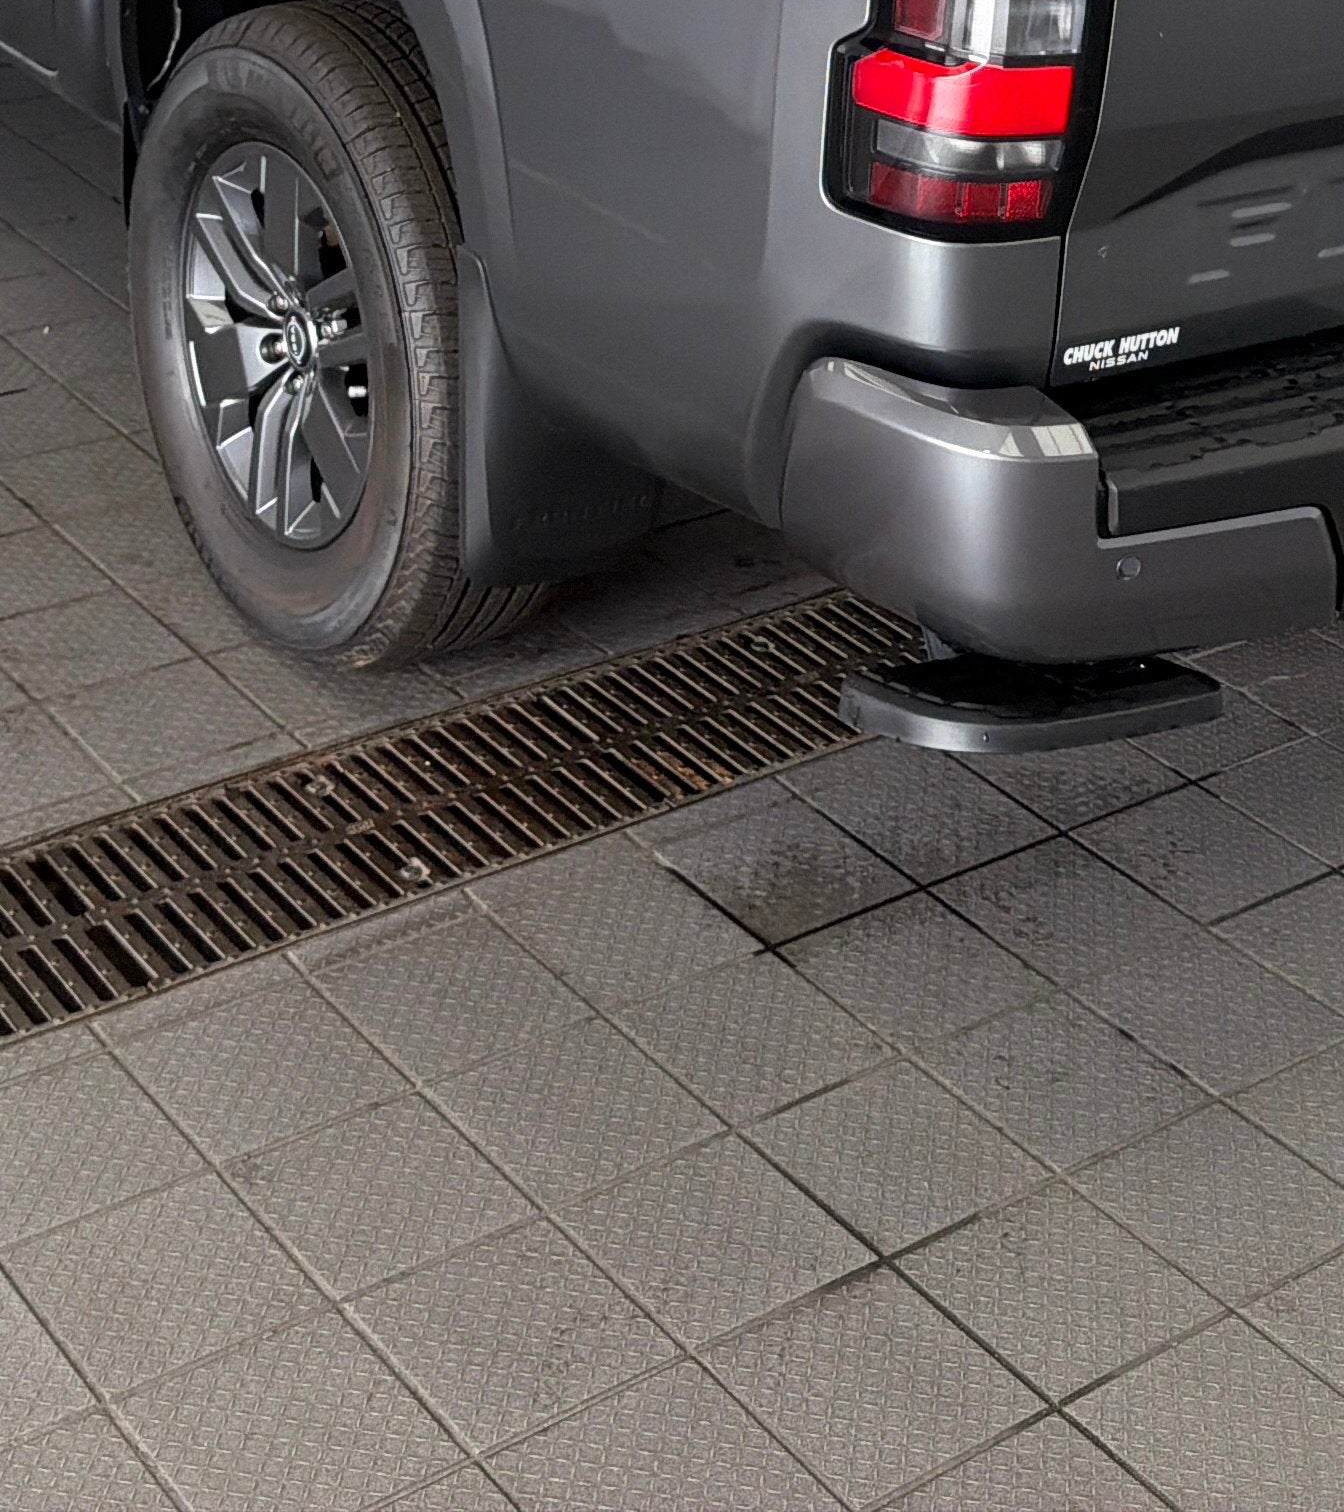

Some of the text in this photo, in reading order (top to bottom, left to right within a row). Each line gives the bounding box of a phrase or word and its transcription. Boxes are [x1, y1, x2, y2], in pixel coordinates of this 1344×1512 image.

[1062, 326, 1181, 366] CHUCK HUTTON
[1088, 350, 1149, 372] NISSAN
